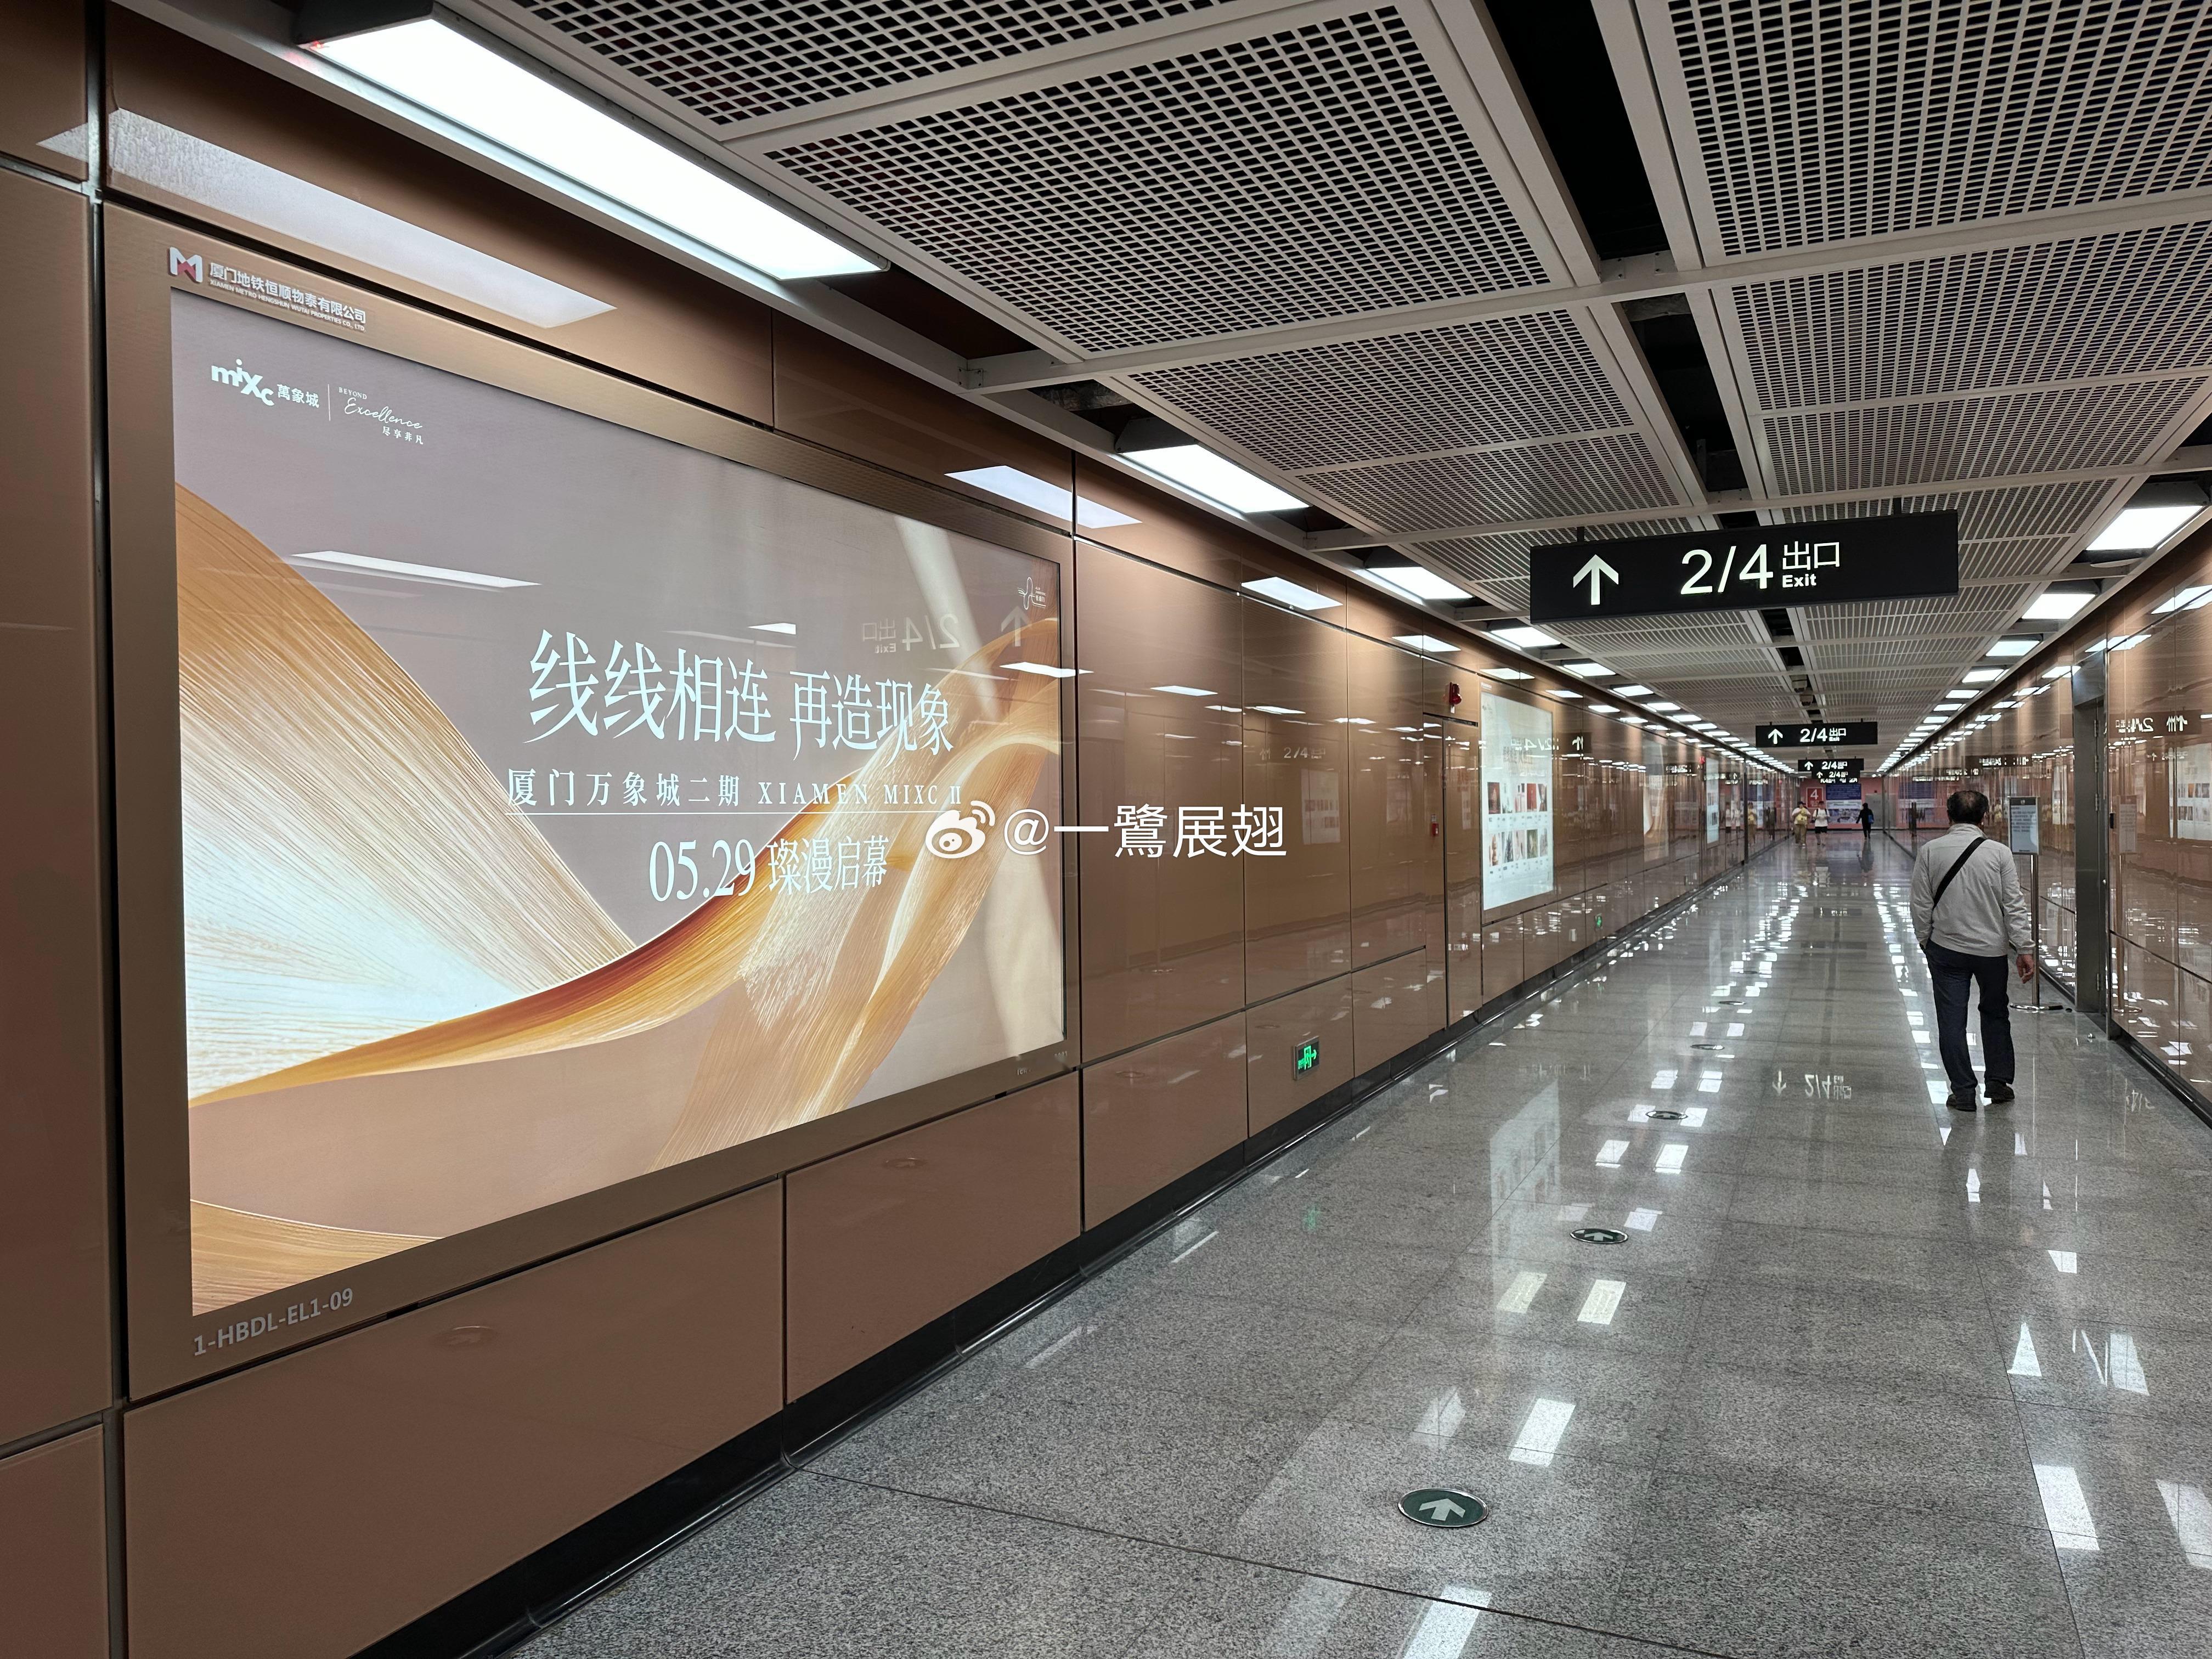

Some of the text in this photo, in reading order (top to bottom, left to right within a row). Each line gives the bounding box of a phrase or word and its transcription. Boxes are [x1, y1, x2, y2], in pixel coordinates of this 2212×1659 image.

[210, 262, 366, 324] 厦门地铁恒顺物泰有限公司
[210, 279, 235, 292] XIAMEN
[235, 287, 257, 301] METRO
[258, 294, 290, 309] HENGSHUN
[291, 304, 311, 315] WUTAI
[311, 310, 342, 324] PROPERTIES
[276, 383, 320, 408] 萬象城
[338, 386, 368, 400] BEYOND
[344, 397, 423, 429] Excellence
[382, 425, 424, 445] 尽享非凡
[1680, 544, 1774, 595] 2/4
[1782, 541, 1840, 570] 出口
[1782, 573, 1817, 588] Exit
[522, 629, 953, 769] 线线相连 再造现象
[1799, 727, 1828, 743] 2/4
[1829, 727, 1847, 737] 出口
[1821, 761, 1837, 770] 2/4
[507, 768, 740, 808] 厦门万象城二期
[758, 781, 869, 805] XIAMEN
[883, 783, 939, 805] MIXC
[1810, 789, 1819, 800] 4
[649, 834, 890, 902] 05.29 璨漫启幕
[194, 1288, 353, 1356] 1-HBDL-EL1-09
